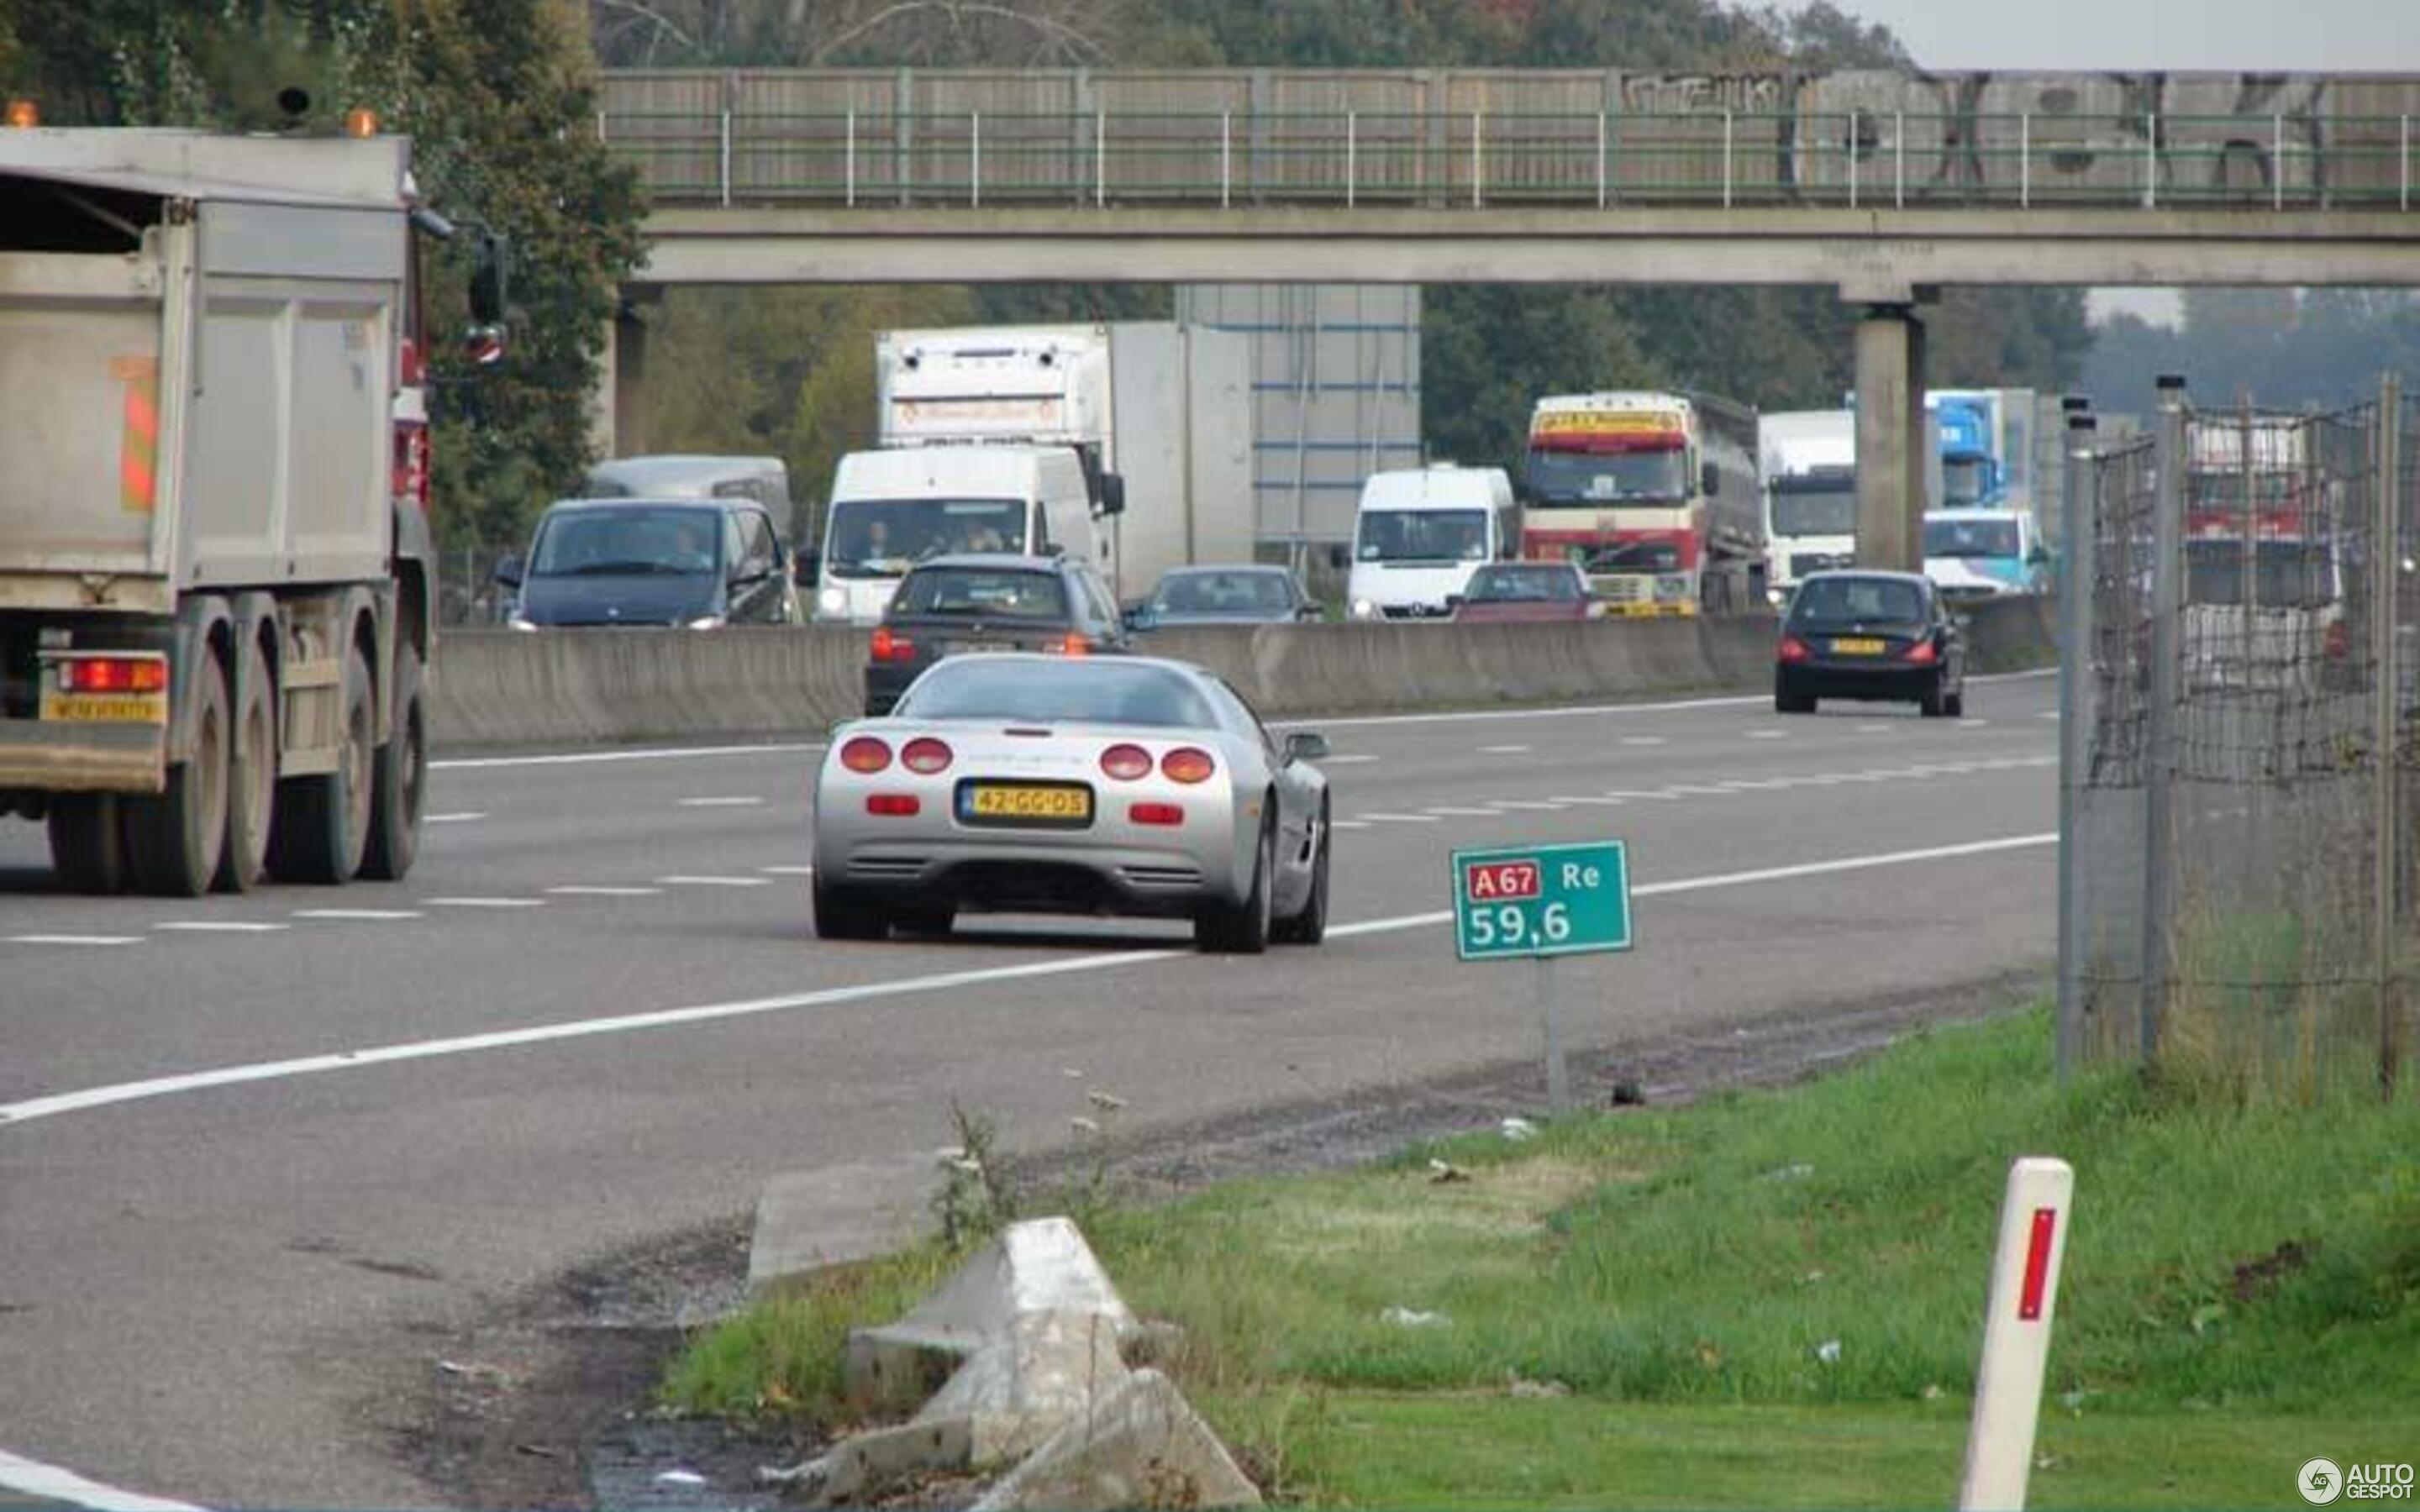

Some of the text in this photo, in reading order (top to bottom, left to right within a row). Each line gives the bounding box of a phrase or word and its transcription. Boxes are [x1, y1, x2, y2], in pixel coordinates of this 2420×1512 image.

[979, 790, 1083, 812] 42-GG-DS
[1475, 862, 1601, 897] A67 Re
[1471, 903, 1571, 945] 59,6
